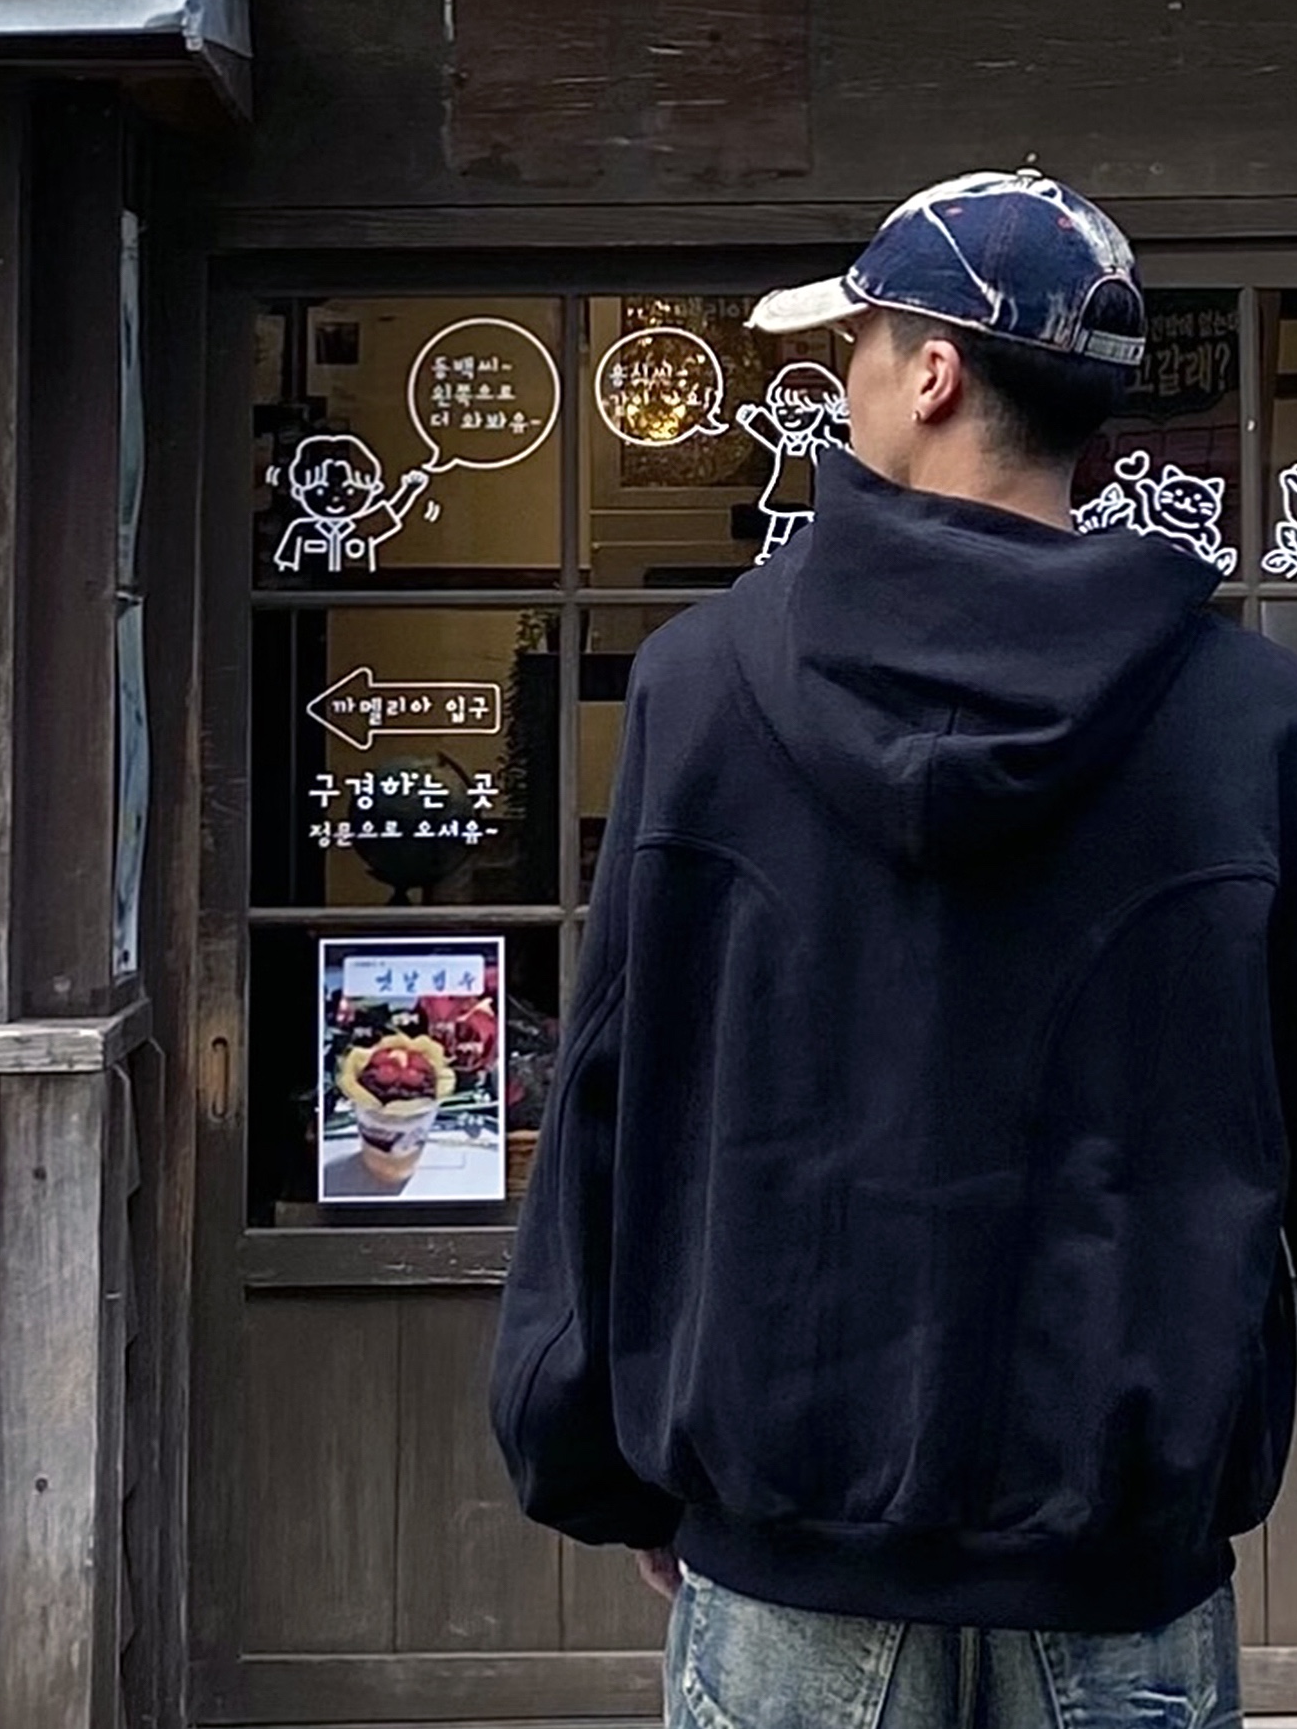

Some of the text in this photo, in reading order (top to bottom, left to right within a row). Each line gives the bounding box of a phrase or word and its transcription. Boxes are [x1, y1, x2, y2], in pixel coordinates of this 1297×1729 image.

[331, 695, 490, 727] 까멜리아 입구
[308, 771, 500, 810] 구경하는 곳
[308, 820, 403, 848] 정문으로
